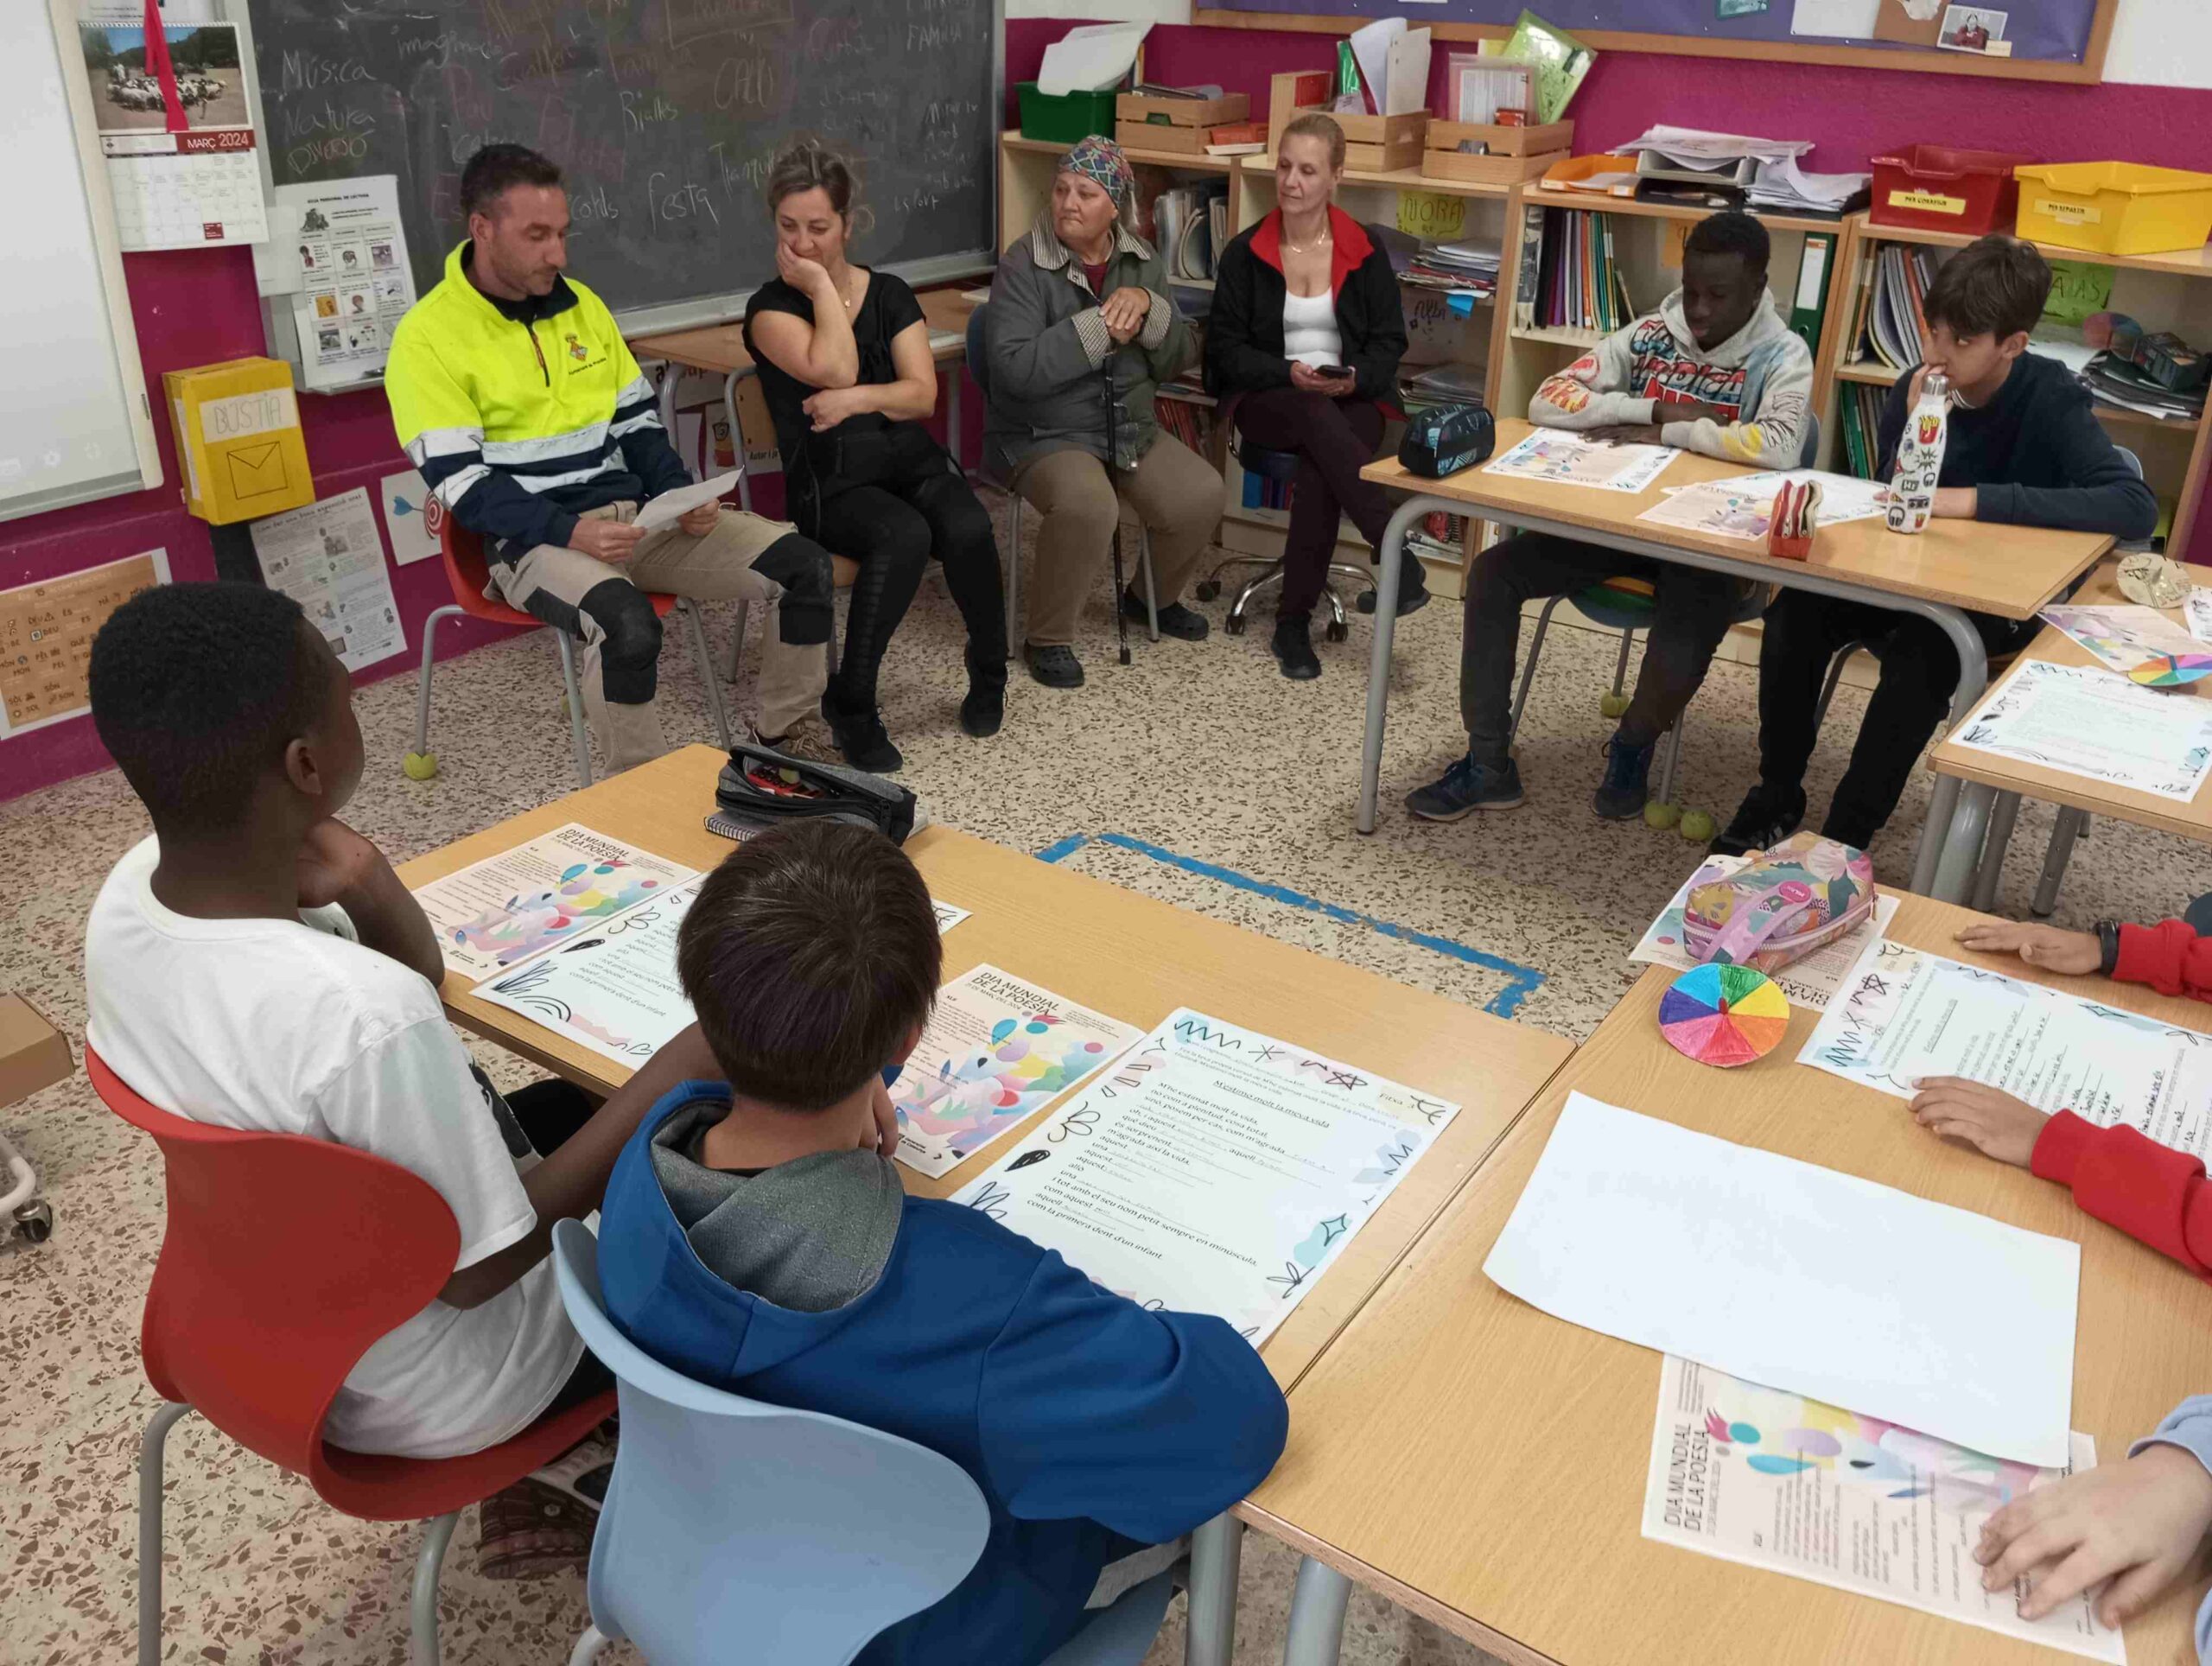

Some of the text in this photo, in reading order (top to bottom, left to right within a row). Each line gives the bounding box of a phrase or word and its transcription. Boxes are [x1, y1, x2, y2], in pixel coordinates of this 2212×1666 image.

[283, 48, 378, 92] Música
[286, 99, 376, 143] Natura
[187, 132, 250, 152] MARÇ 2024
[1403, 196, 1465, 225] NORA
[556, 832, 573, 841] DE
[565, 829, 630, 857] DIA MUNDIAL
[971, 976, 990, 989] DE
[989, 984, 1005, 996] LA
[979, 971, 1060, 1012] DIA MUNDIAL
[1801, 994, 1828, 1008] DIA
[1158, 1082, 1178, 1093] M'he
[1178, 1091, 1210, 1105] estimat
[1210, 1103, 1230, 1114] molt
[1212, 1080, 1254, 1100] M'estimo
[1254, 1096, 1275, 1109] molt
[1274, 1103, 1285, 1112] la
[1285, 1108, 1310, 1122] meva
[1310, 1118, 1331, 1129] vida
[1379, 1092, 1404, 1106] Fitxa
[1162, 1095, 1182, 1104] com
[1225, 1118, 1245, 1129] cosa
[1107, 1128, 1146, 1147] m'agrada
[1126, 1126, 1172, 1147] sorprenent
[1138, 1121, 1157, 1131] dieu
[1163, 1103, 1192, 1117] posem
[1192, 1114, 1208, 1123] per
[1225, 1128, 1246, 1139] com
[1246, 1135, 1286, 1155] m'agrada
[1091, 1141, 1108, 1151] una
[1099, 1135, 1128, 1149] aquest
[1147, 1116, 1176, 1129] aquest
[1229, 1147, 1256, 1161] aquell
[1084, 1148, 1113, 1163] aquest
[1060, 1169, 1077, 1180] una
[1067, 1162, 1084, 1173] allò
[1035, 1192, 1064, 1206] aquell
[1044, 1184, 1094, 1209] com aquest
[1057, 1178, 1071, 1187] tot
[1071, 1185, 1091, 1196] amb
[1100, 1198, 1116, 1207] seu
[1116, 1204, 1138, 1217] nom
[1137, 1211, 1160, 1226] petit
[1160, 1223, 1196, 1242] sempre
[1195, 1236, 1209, 1246] en
[1027, 1199, 1164, 1261] com la primera dent d'un infant
[1668, 1422, 1691, 1497] MUNDIAL
[1687, 1488, 1705, 1511] LA
[1663, 1497, 1683, 1528] DIA
[1684, 1510, 1701, 1533] DE
